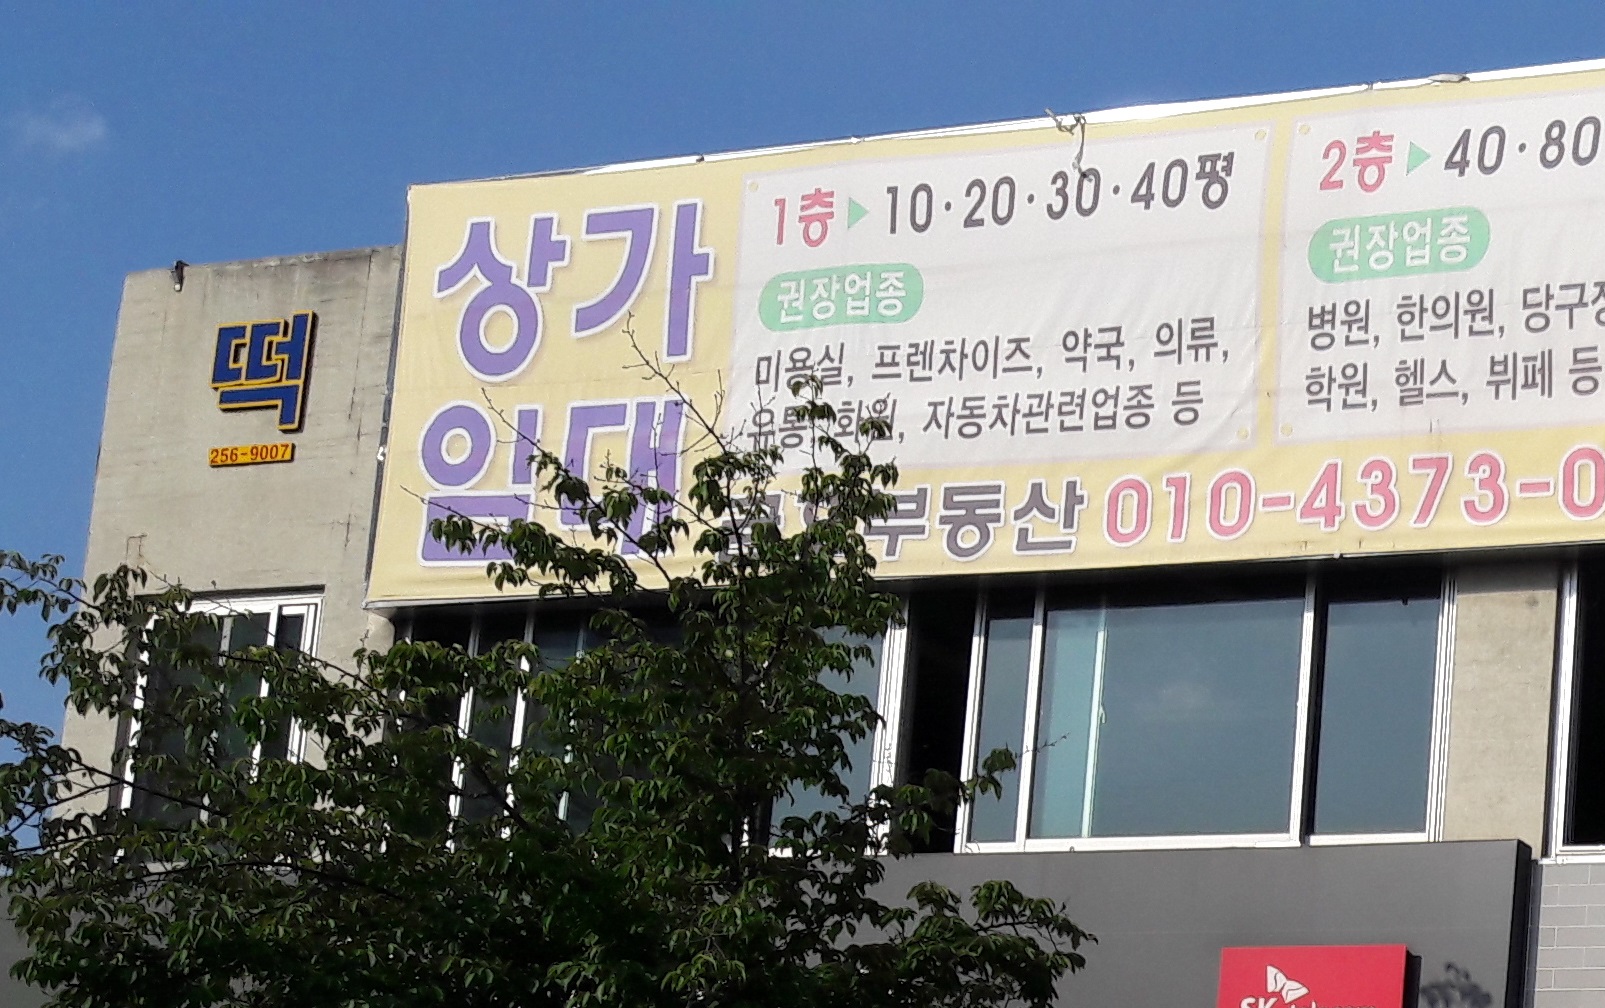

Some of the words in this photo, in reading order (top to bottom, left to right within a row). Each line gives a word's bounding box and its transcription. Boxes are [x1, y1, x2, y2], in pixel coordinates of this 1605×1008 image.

[1320, 131, 1395, 192] 2층
[775, 188, 835, 248] 1층
[1329, 215, 1471, 274] 권장업종
[434, 201, 712, 378] 상가
[777, 269, 907, 324] 권장업종
[1307, 299, 1380, 350] 병원,
[1396, 287, 1505, 340] 한의원,
[209, 311, 315, 432] 떡
[755, 342, 853, 392] 미용실,
[872, 335, 1043, 383] 프렌차이즈,
[1061, 326, 1135, 373] 약국,
[1154, 316, 1230, 365] 의류,
[1305, 361, 1378, 411] 학원,
[1395, 355, 1470, 407] 헬스,
[1486, 351, 1553, 400] 뷔페
[1568, 346, 1603, 396] 등
[922, 384, 1154, 440] 자동차관련업종
[1170, 380, 1204, 426] 등
[210, 443, 290, 465] 256-9007
[420, 400, 686, 564] 임대
